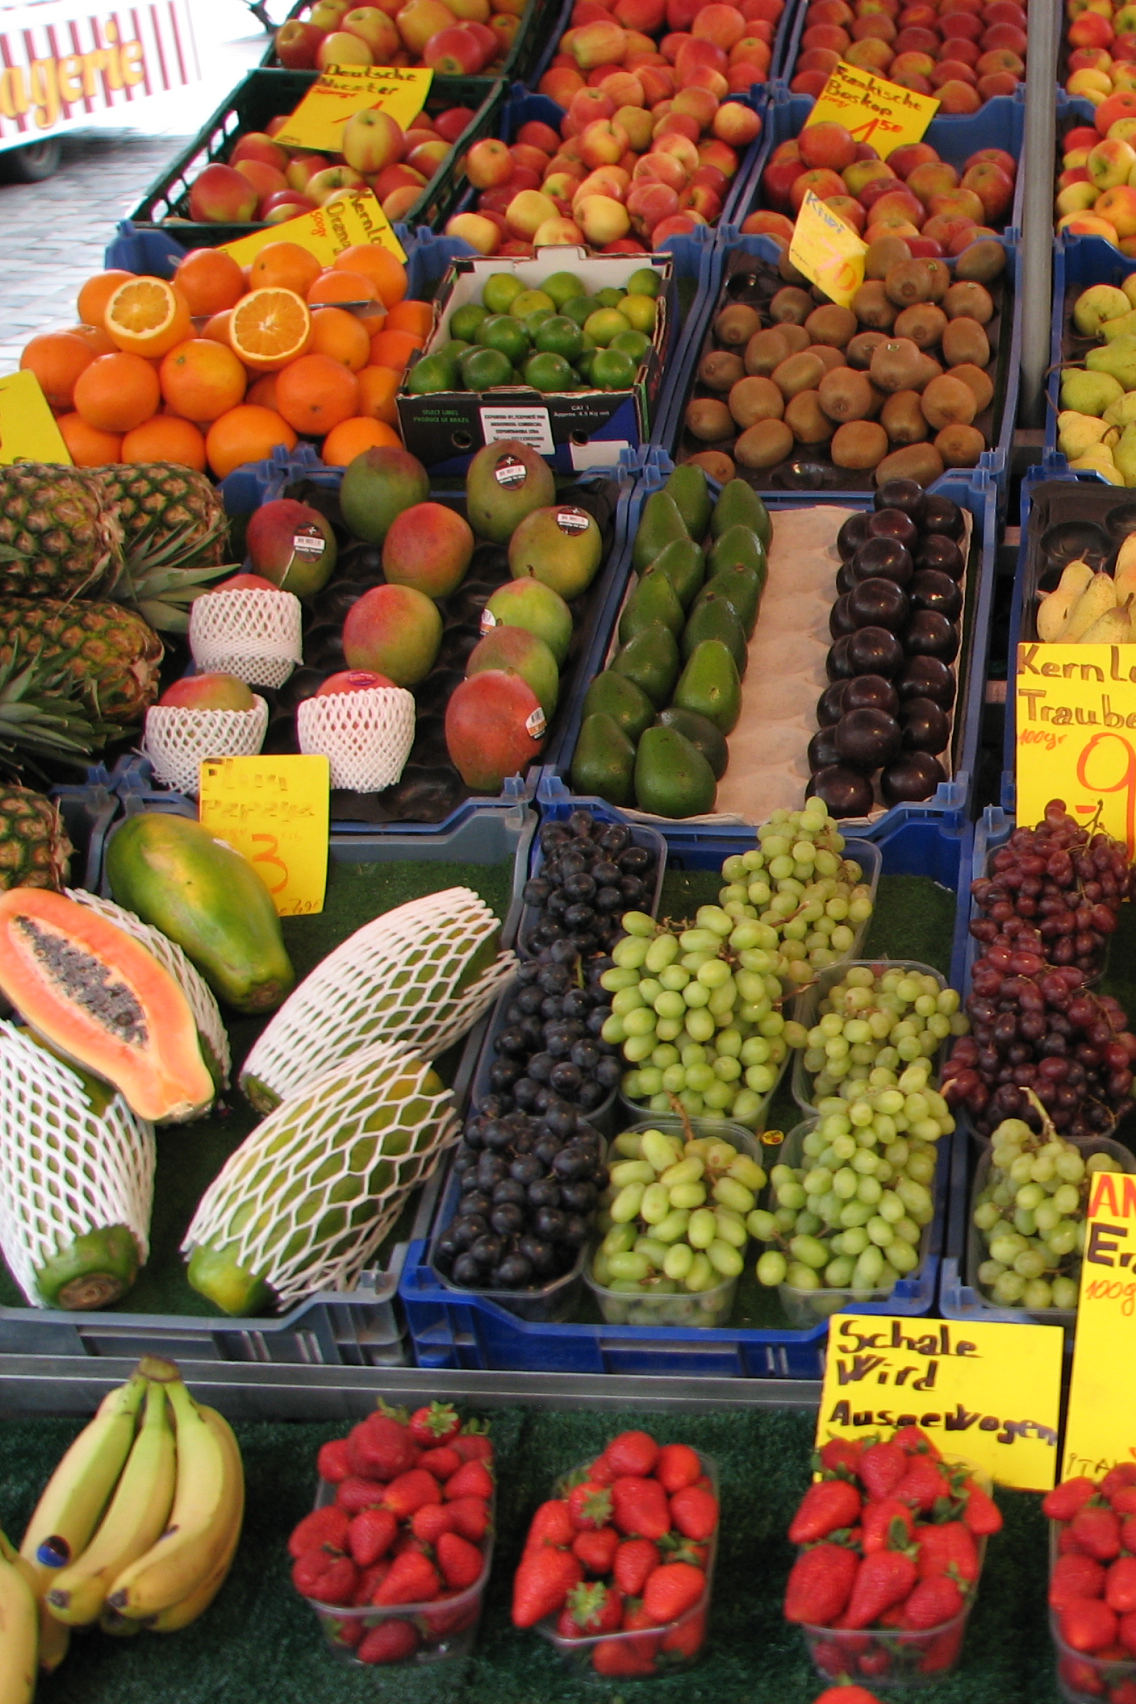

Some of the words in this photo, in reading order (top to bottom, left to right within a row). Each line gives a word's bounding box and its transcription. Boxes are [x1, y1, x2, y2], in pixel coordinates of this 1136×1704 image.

[348, 190, 389, 251] Kernlo
[251, 833, 289, 895] 3
[836, 1319, 984, 1359] Schale
[836, 1353, 940, 1392] Wird
